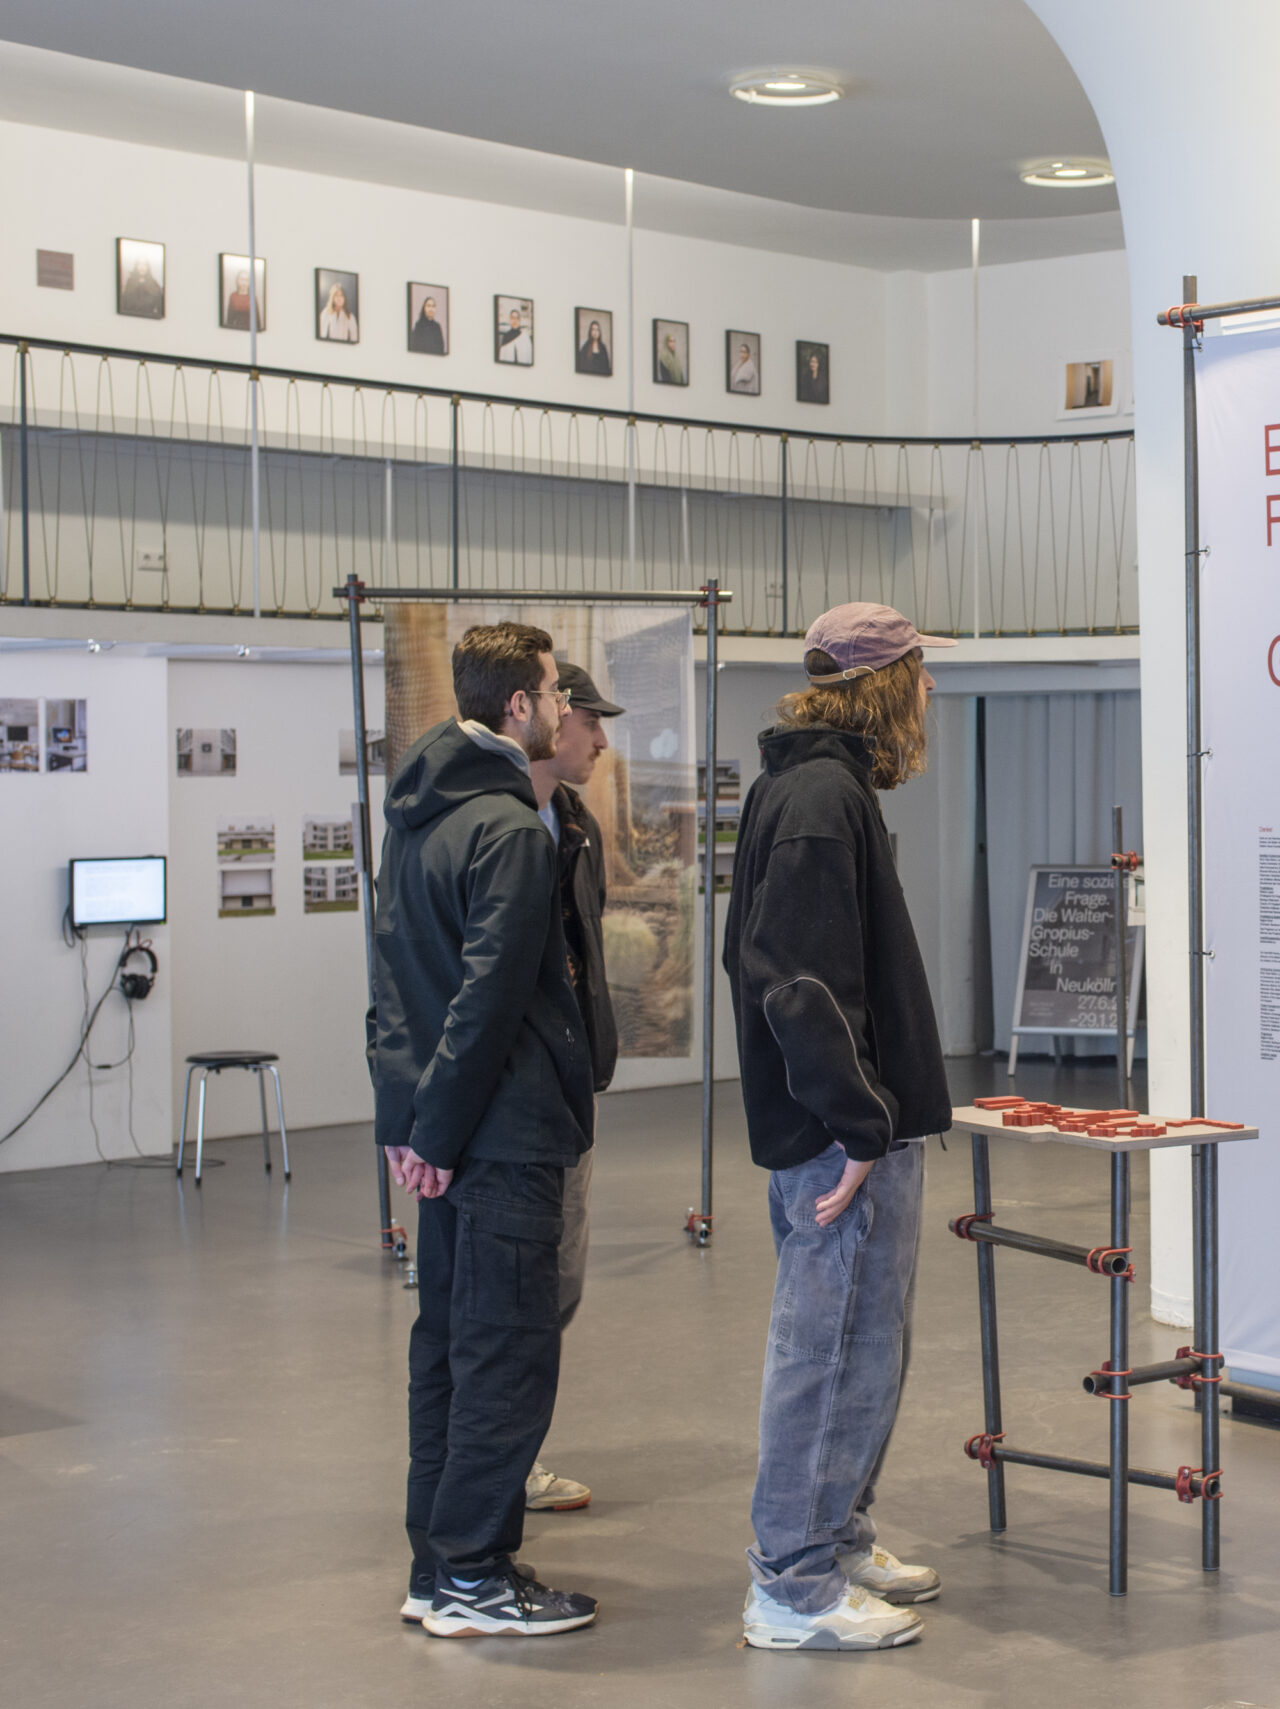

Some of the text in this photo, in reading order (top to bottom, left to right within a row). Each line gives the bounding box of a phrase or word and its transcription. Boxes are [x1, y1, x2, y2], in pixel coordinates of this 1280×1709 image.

[1048, 873, 1079, 889] Eine
[1065, 891, 1110, 909] Frage.
[1033, 908, 1114, 923] Die Walter-
[1031, 925, 1095, 943] Gropius-
[1029, 942, 1079, 957] Schule
